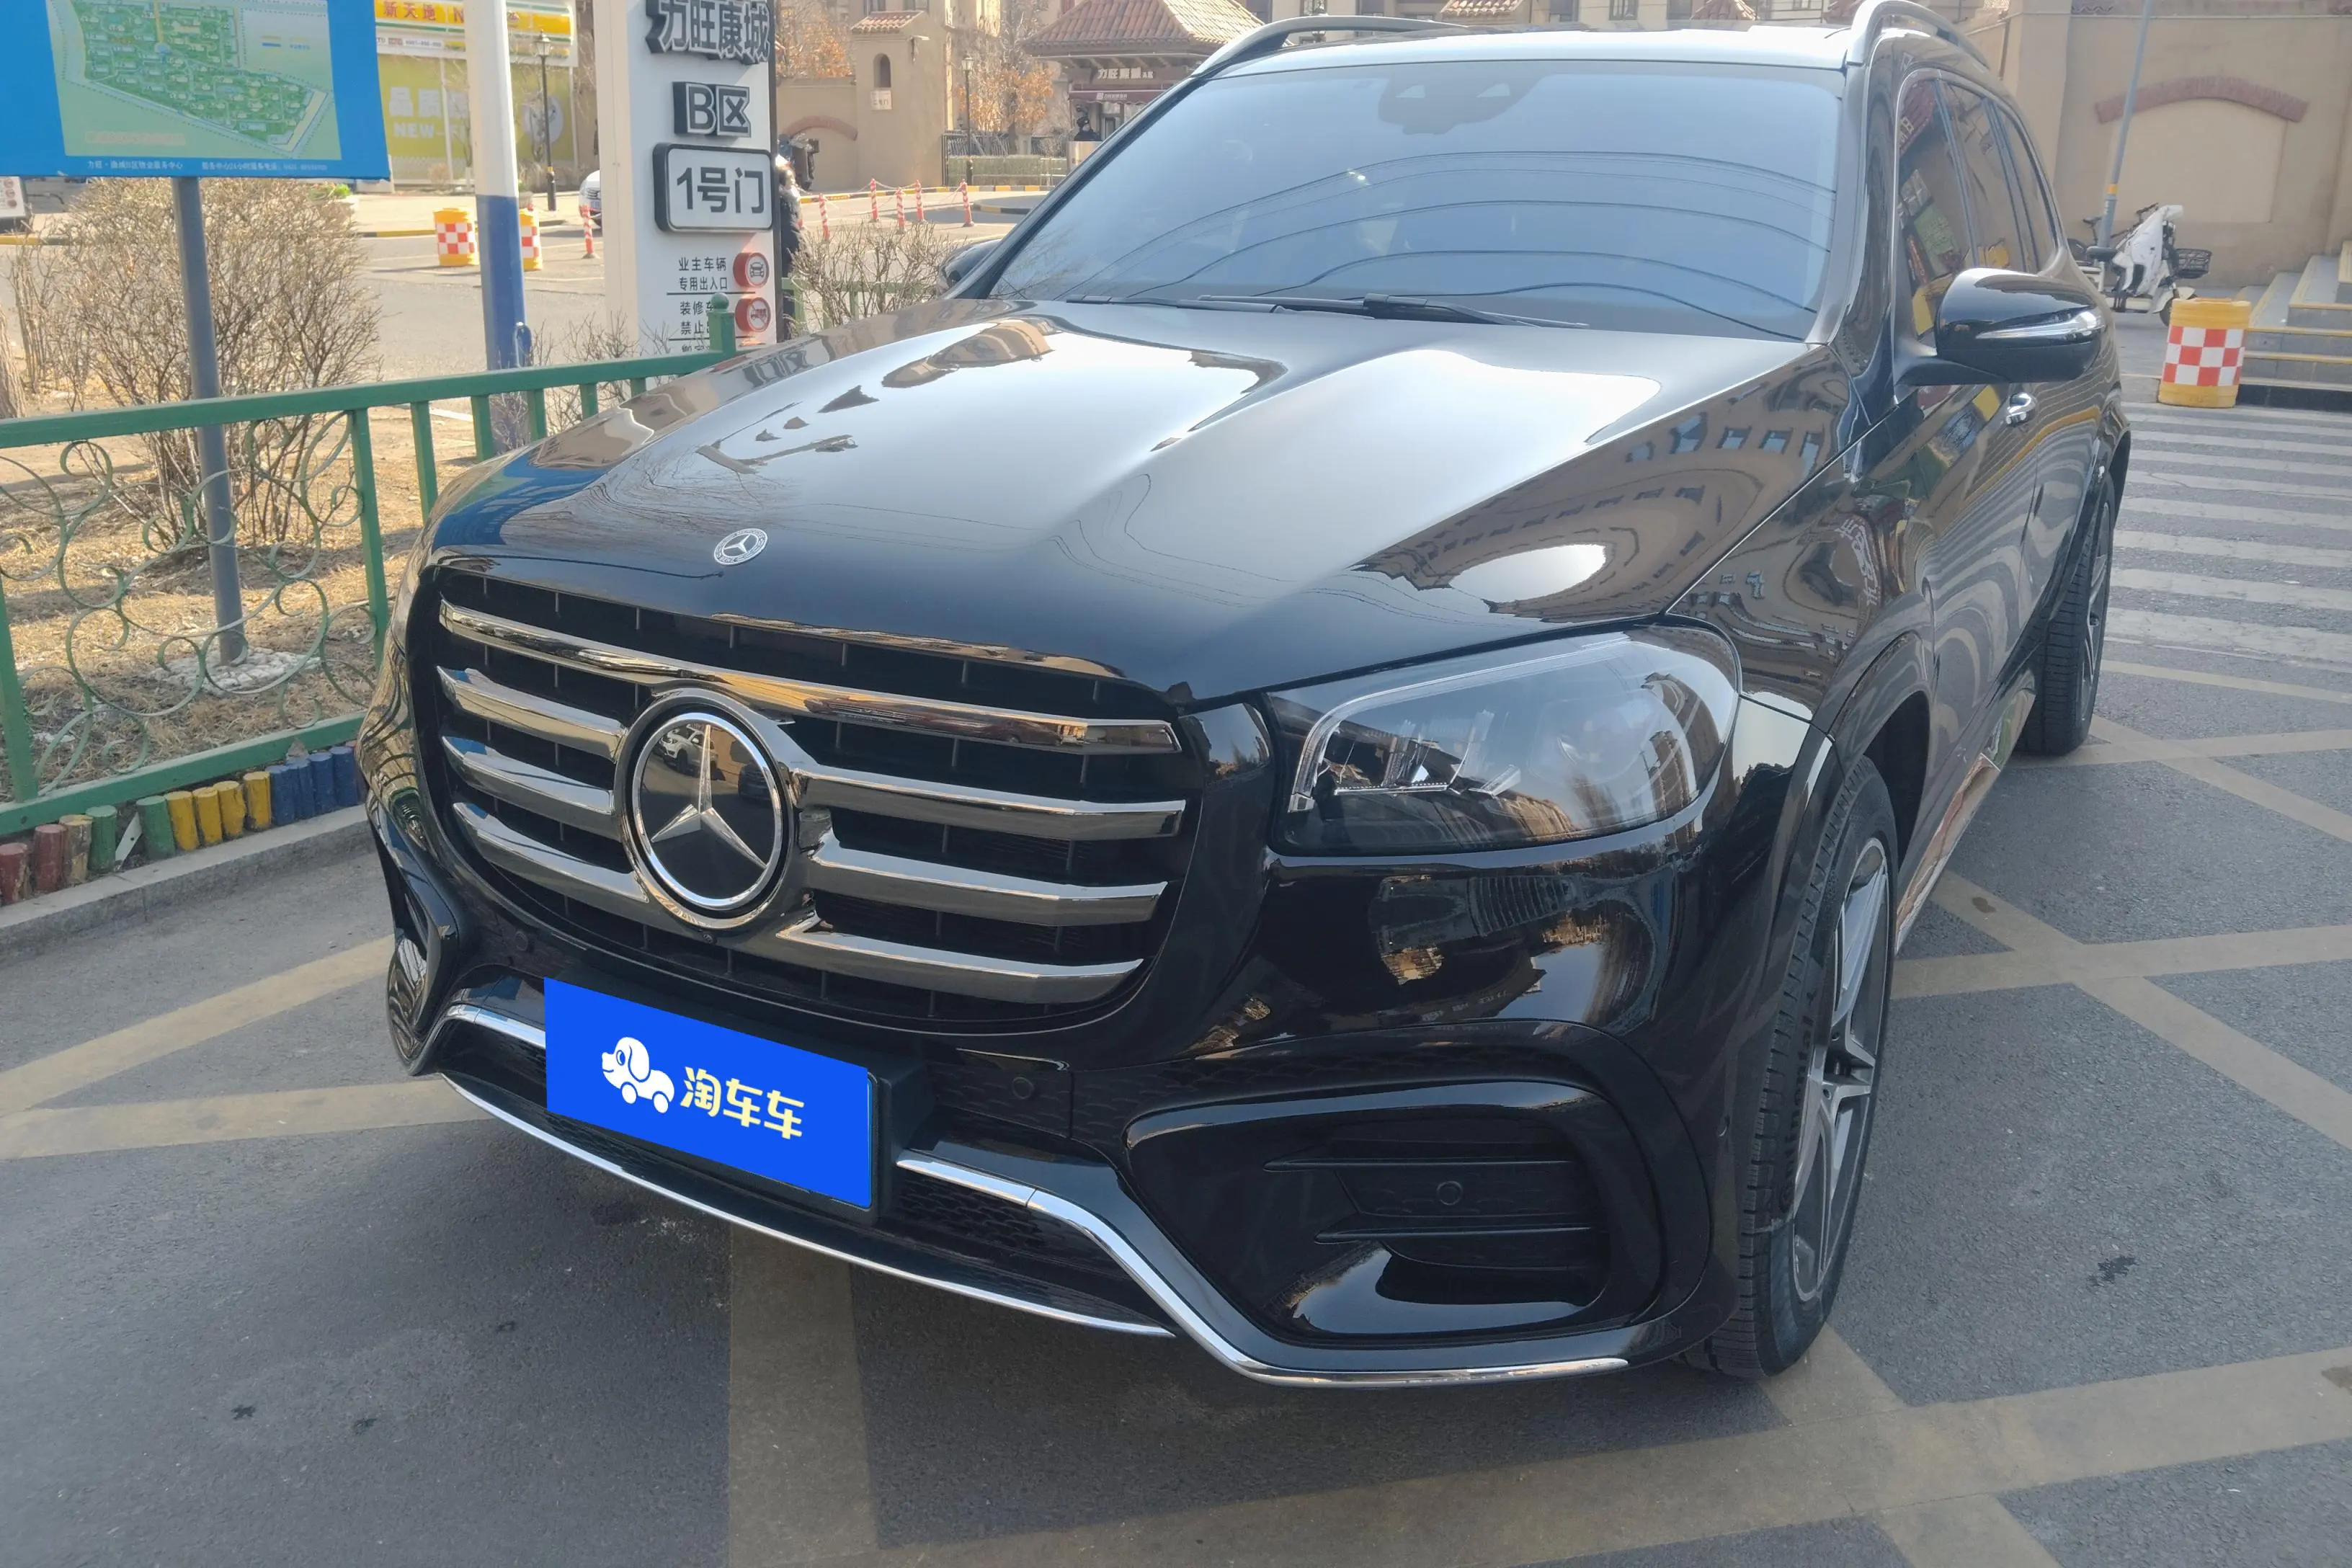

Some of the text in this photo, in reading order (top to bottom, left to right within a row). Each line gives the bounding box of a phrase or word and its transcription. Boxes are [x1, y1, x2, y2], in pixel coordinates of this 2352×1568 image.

[383, 1, 436, 21] 新天地
[658, 0, 770, 62] 力旺康城
[686, 83, 752, 137] B区
[677, 167, 765, 214] 1号门
[679, 257, 726, 272] 业主车辆
[680, 277, 728, 291] 专用出入口
[680, 300, 715, 316] 装修车
